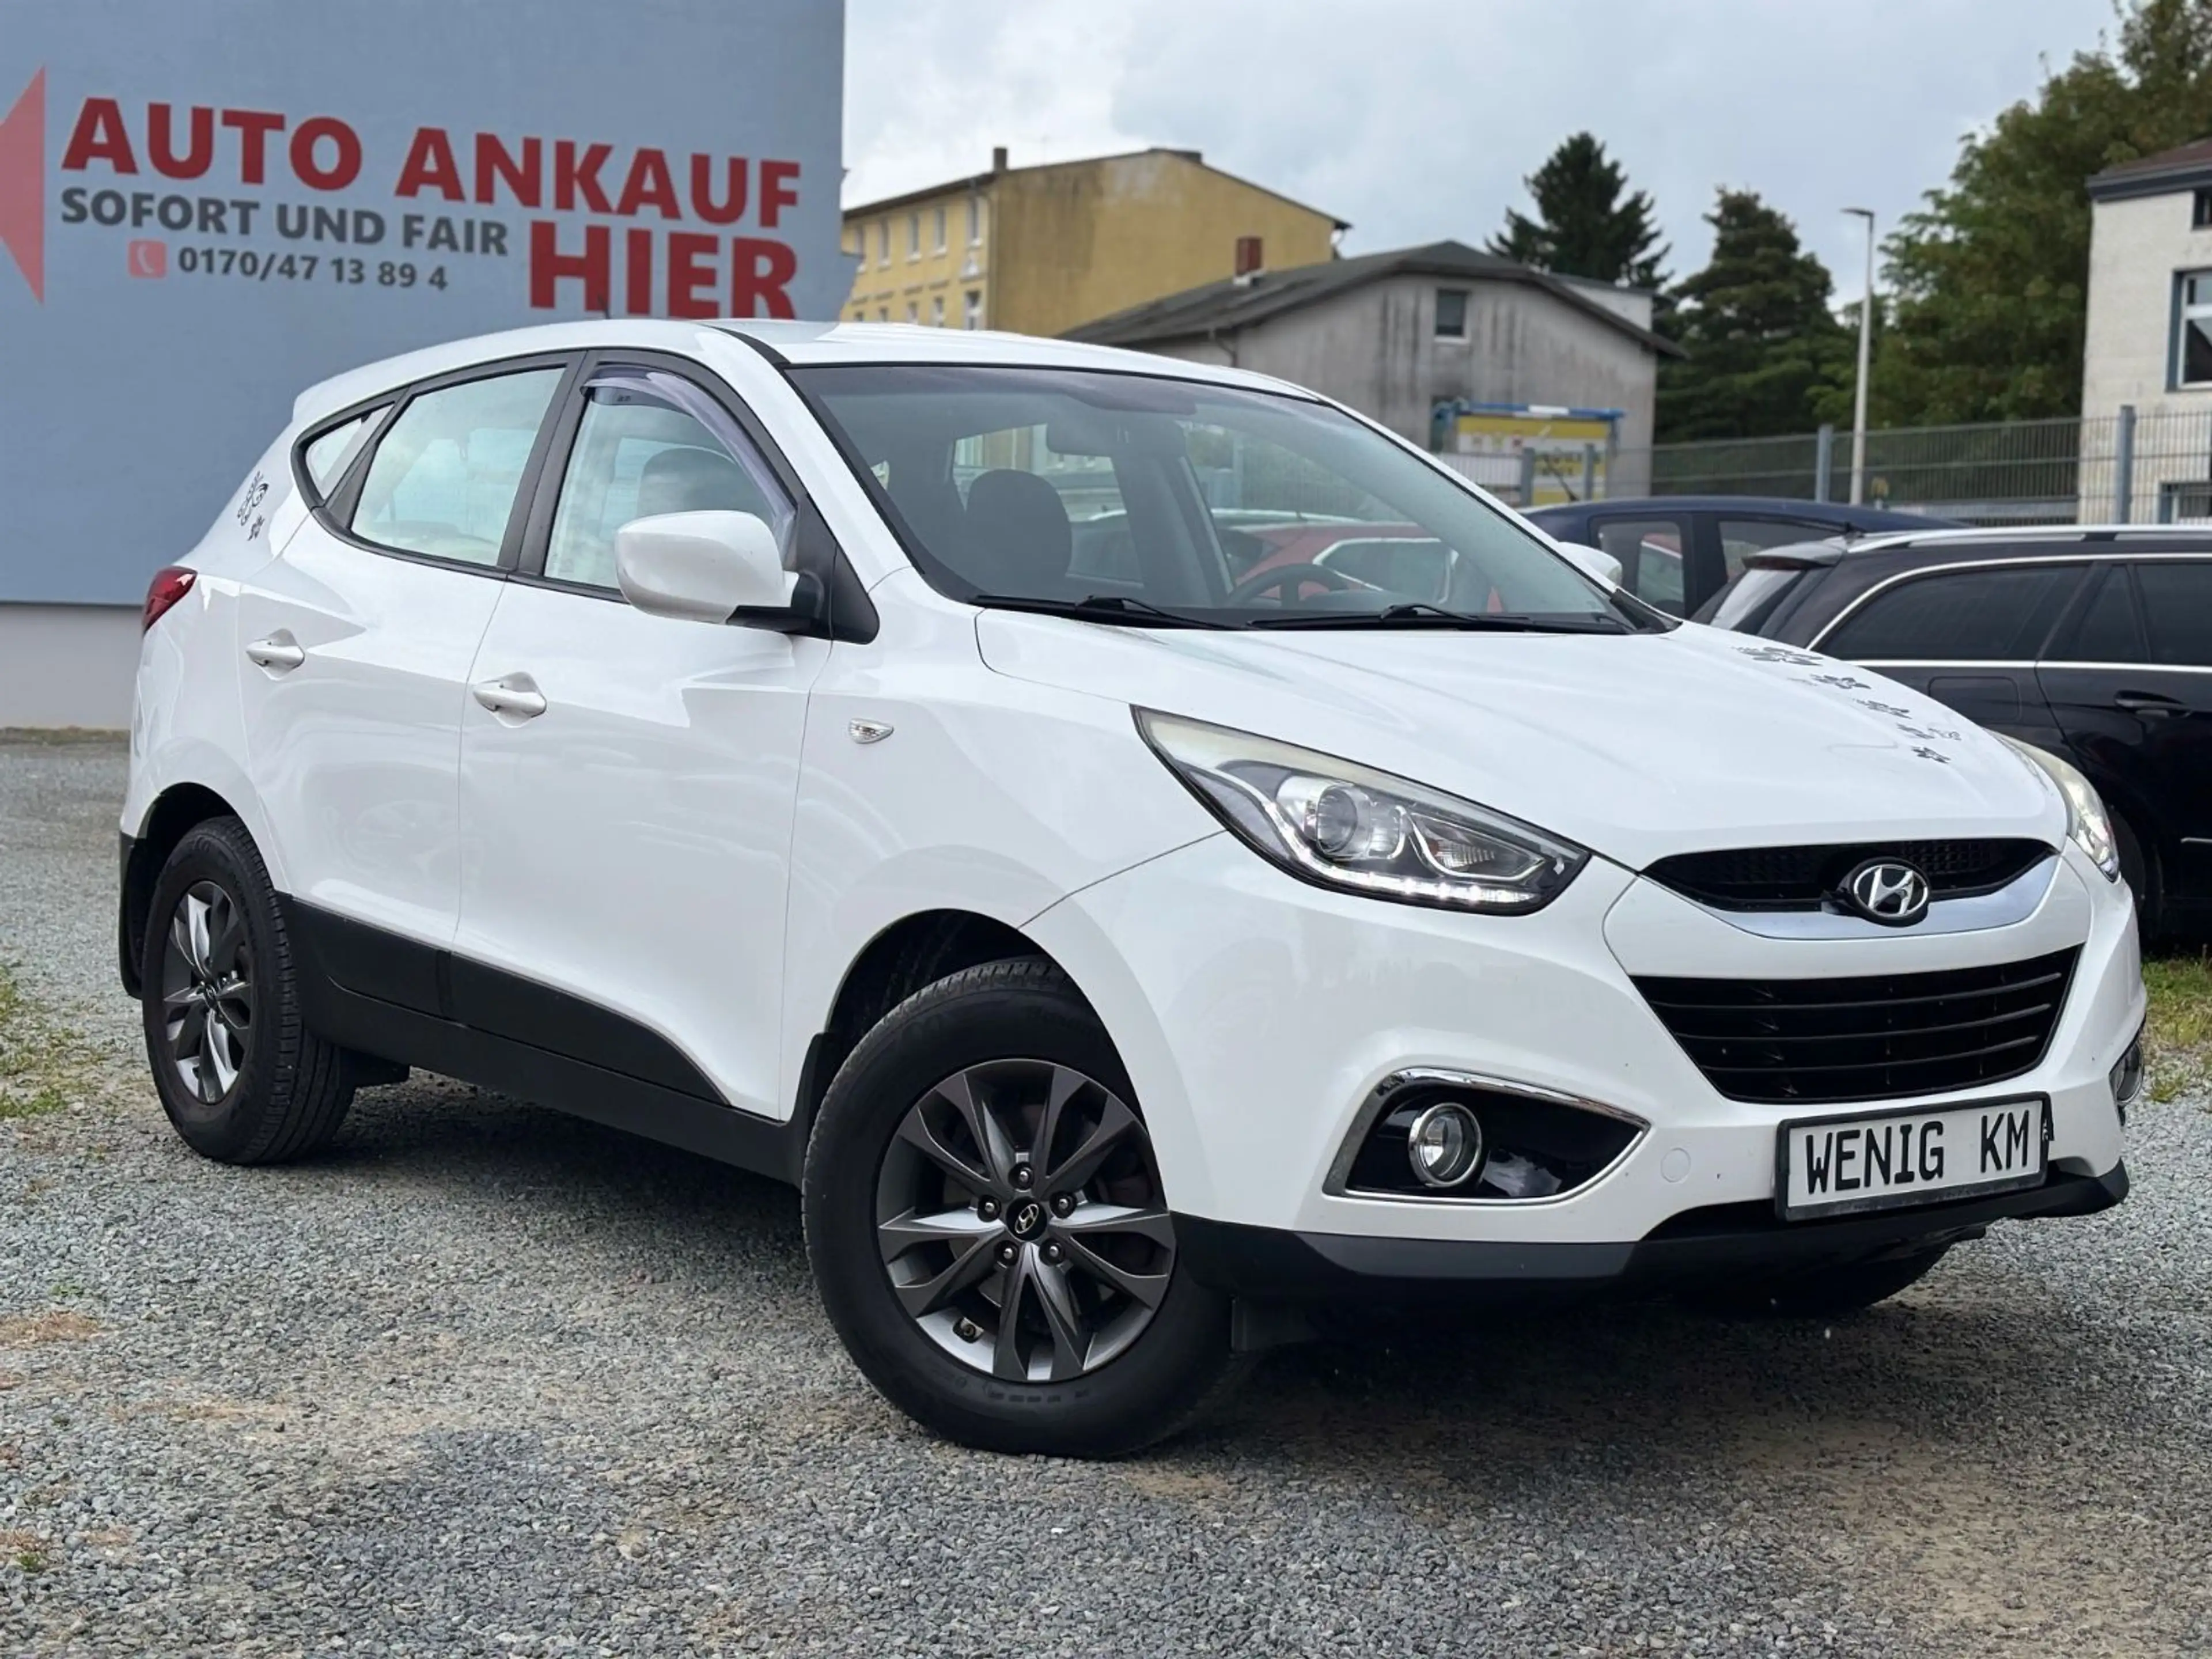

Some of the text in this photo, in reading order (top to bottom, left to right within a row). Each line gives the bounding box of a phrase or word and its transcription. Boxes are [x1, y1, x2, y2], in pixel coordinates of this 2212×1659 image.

[62, 97, 801, 229] AUTO ANKAUF
[62, 187, 509, 256] SOFORT UND FAIR
[179, 247, 448, 291] 0170/47 13 89 4
[529, 219, 798, 320] HIER
[1805, 1109, 2031, 1195] WENIG KM
